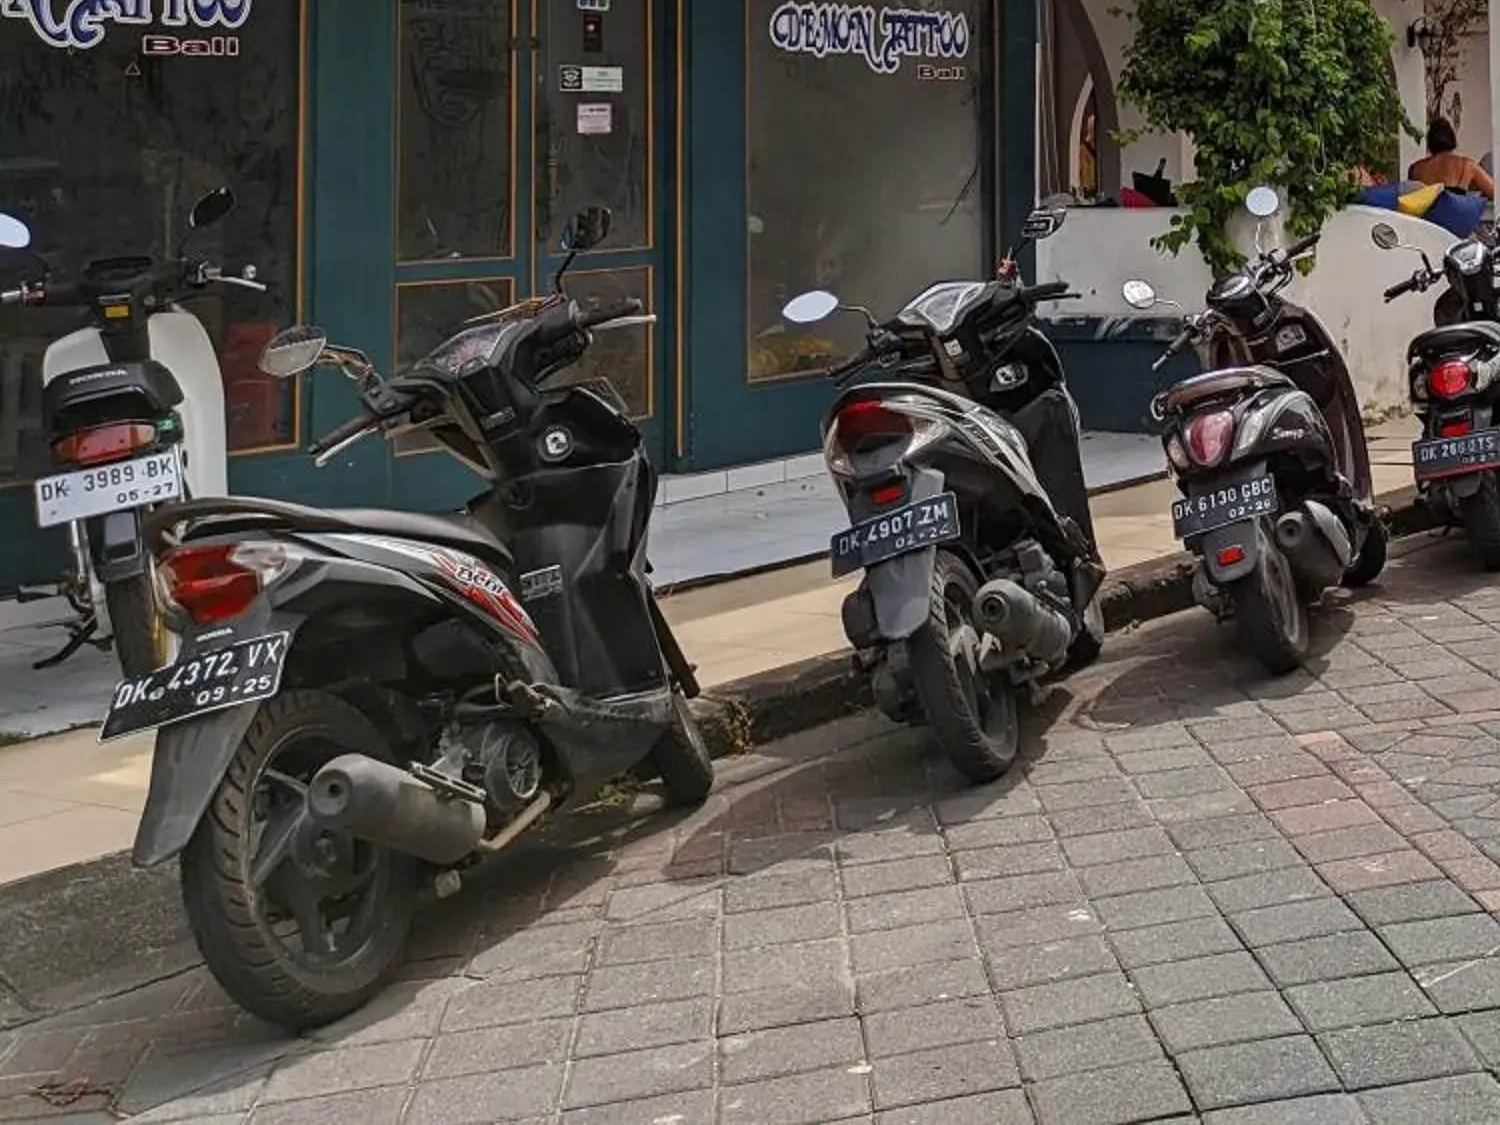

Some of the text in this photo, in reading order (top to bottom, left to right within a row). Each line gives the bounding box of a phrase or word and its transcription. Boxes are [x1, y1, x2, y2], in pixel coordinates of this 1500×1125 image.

[142, 35, 239, 56] Bali
[40, 457, 173, 502] DK 3989 BK
[1173, 478, 1271, 520] DK 6130 GBC
[839, 530, 861, 556] DK
[113, 676, 151, 710] DK
[249, 639, 281, 668] VX
